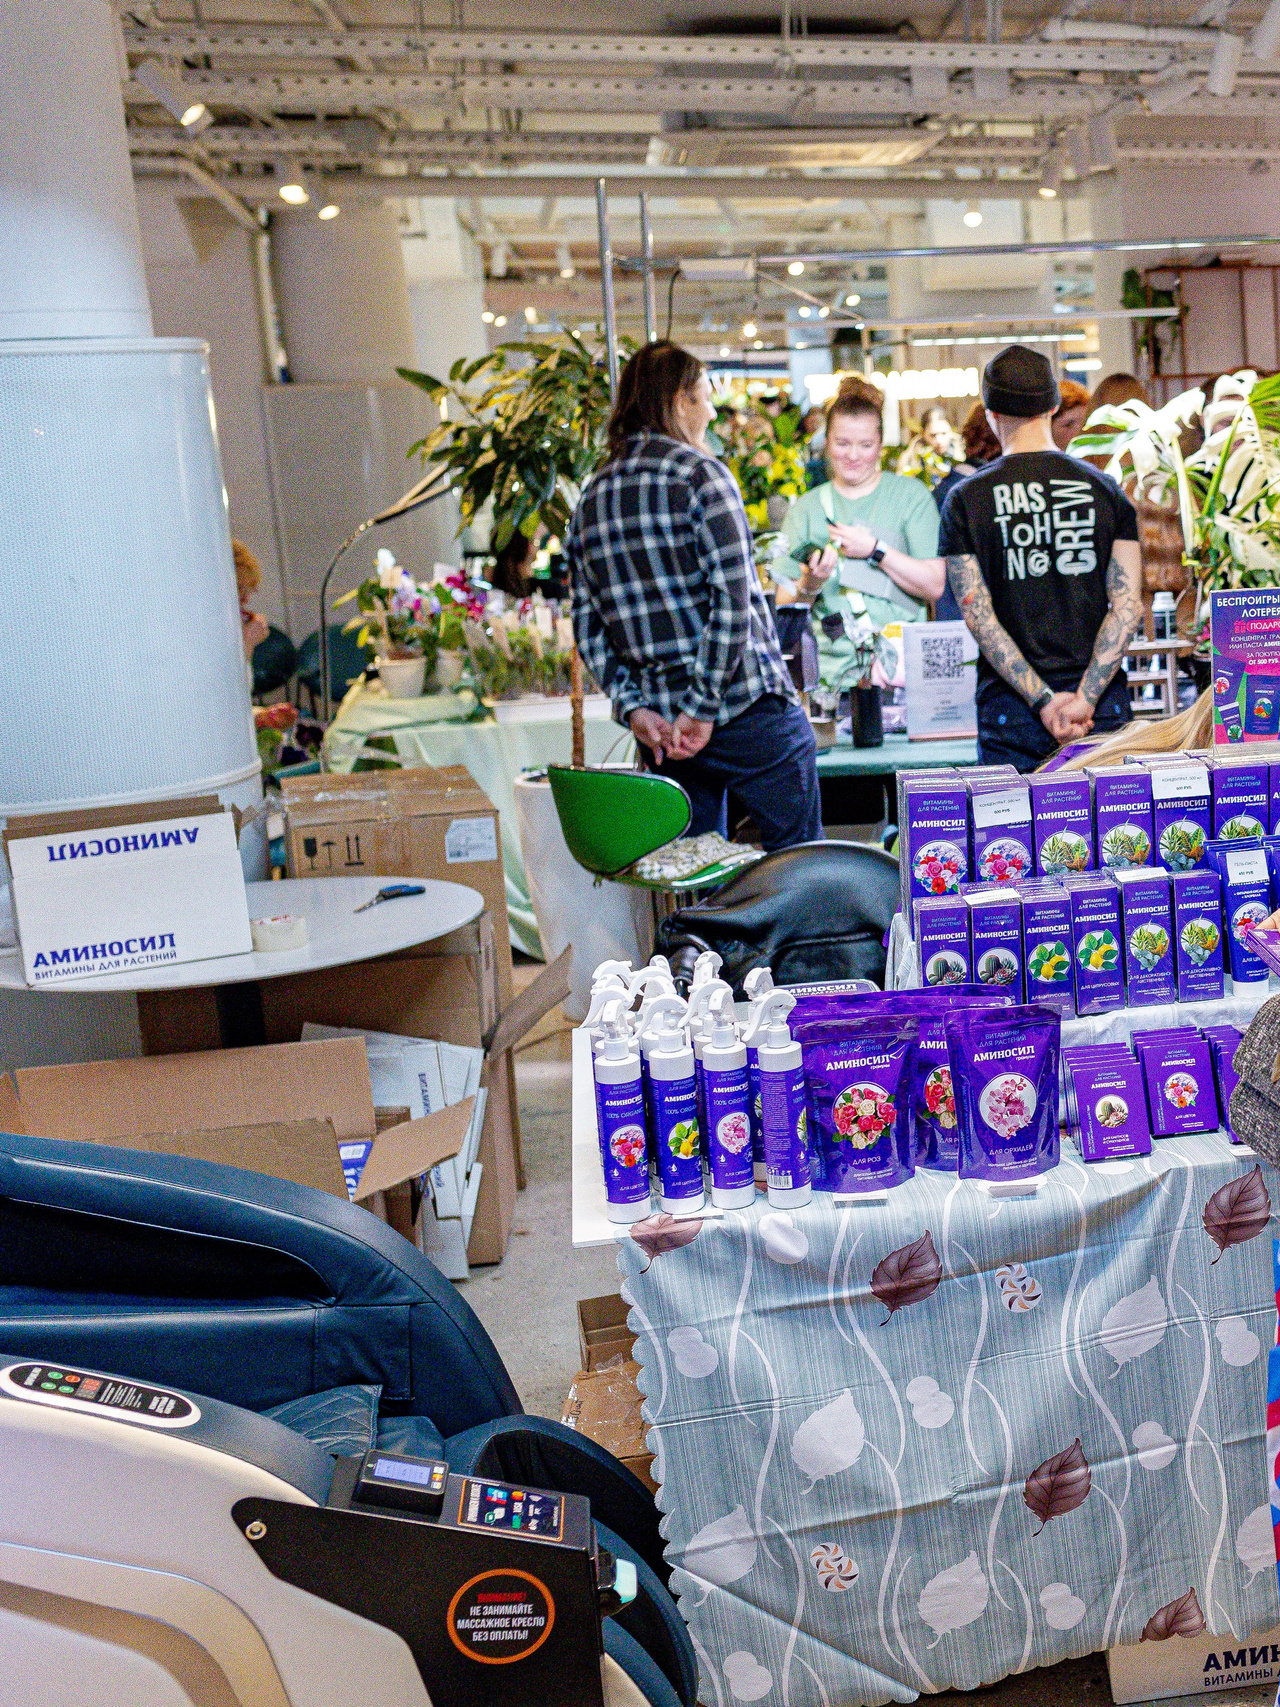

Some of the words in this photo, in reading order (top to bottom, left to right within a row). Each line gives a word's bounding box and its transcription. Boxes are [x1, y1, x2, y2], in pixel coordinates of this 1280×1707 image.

[992, 481, 1047, 515] RAS
[1049, 479, 1097, 576] CREW
[1110, 783, 1140, 791] ВИТАМИНЫ
[1222, 781, 1234, 789] ДЛЯ
[1234, 780, 1261, 788] РАСТЕНИЙ
[1046, 789, 1077, 797] ВИТАМИНЫ
[1117, 788, 1145, 796] РАСТЕНИЙ
[1041, 797, 1053, 805] ДЛЯ
[1054, 794, 1082, 803] РАСТЕНИЙ
[1157, 798, 1208, 810] АМИНОСИЛ
[1216, 794, 1267, 805] АМИНОСИЛ
[917, 805, 930, 813] ДЛЯ
[931, 804, 960, 812] РАСТЕНИЙ
[1099, 801, 1151, 814] АМИНОСИЛ
[1036, 808, 1089, 821] АМИНОСИЛ
[911, 818, 966, 828] АМИНОСИЛ
[47, 827, 199, 862] АМИНОСИЛ
[1089, 901, 1112, 909] РАСТЕНИЙ
[1127, 904, 1169, 915] АМИНОСИЛ
[1177, 900, 1219, 910] АМИНОСИЛ
[1074, 912, 1118, 923] АМИНОСИЛ
[975, 929, 1019, 940] АМИНОСИЛ
[1026, 924, 1070, 934] АМИНОСИЛ
[922, 932, 967, 942] АМИНОСИЛ
[32, 933, 176, 968] АМИНОСИЛ
[35, 964, 95, 980] ВИТАМИНЫ
[98, 961, 121, 971] ДЛЯ
[123, 951, 177, 968] РАСТЕНИЙ
[787, 983, 857, 995] МИНОСИЛ
[985, 1029, 1020, 1039] ВИТАМИНЫ
[839, 1037, 876, 1048] ВИТАМИНЫ
[978, 1040, 993, 1048] ДЛЯ
[994, 1035, 1027, 1046] РАСТЕНИЙ
[833, 1047, 848, 1056] ДЛЯ
[973, 1045, 1035, 1063] АМИНОСИЛ
[825, 1054, 890, 1071] АМИНОСИЛ
[1161, 1058, 1196, 1067] АМИНОСИЛ
[1091, 1080, 1127, 1090] АМИНОСИЛ
[1003, 1142, 1034, 1154] ОРХИДЕЙ
[852, 1158, 865, 1166] ДЛЯ
[866, 1155, 881, 1164] РОЗ
[469, 1605, 482, 1616] НЕ
[482, 1602, 534, 1615] ЗАНИМАЙТЕ
[456, 1617, 511, 1630] МАССАЖНОЕ
[511, 1616, 545, 1628] КРЕСЛО
[472, 1631, 489, 1642] БЕЗ
[1204, 1667, 1273, 1687] ВИТАМИНЫ
